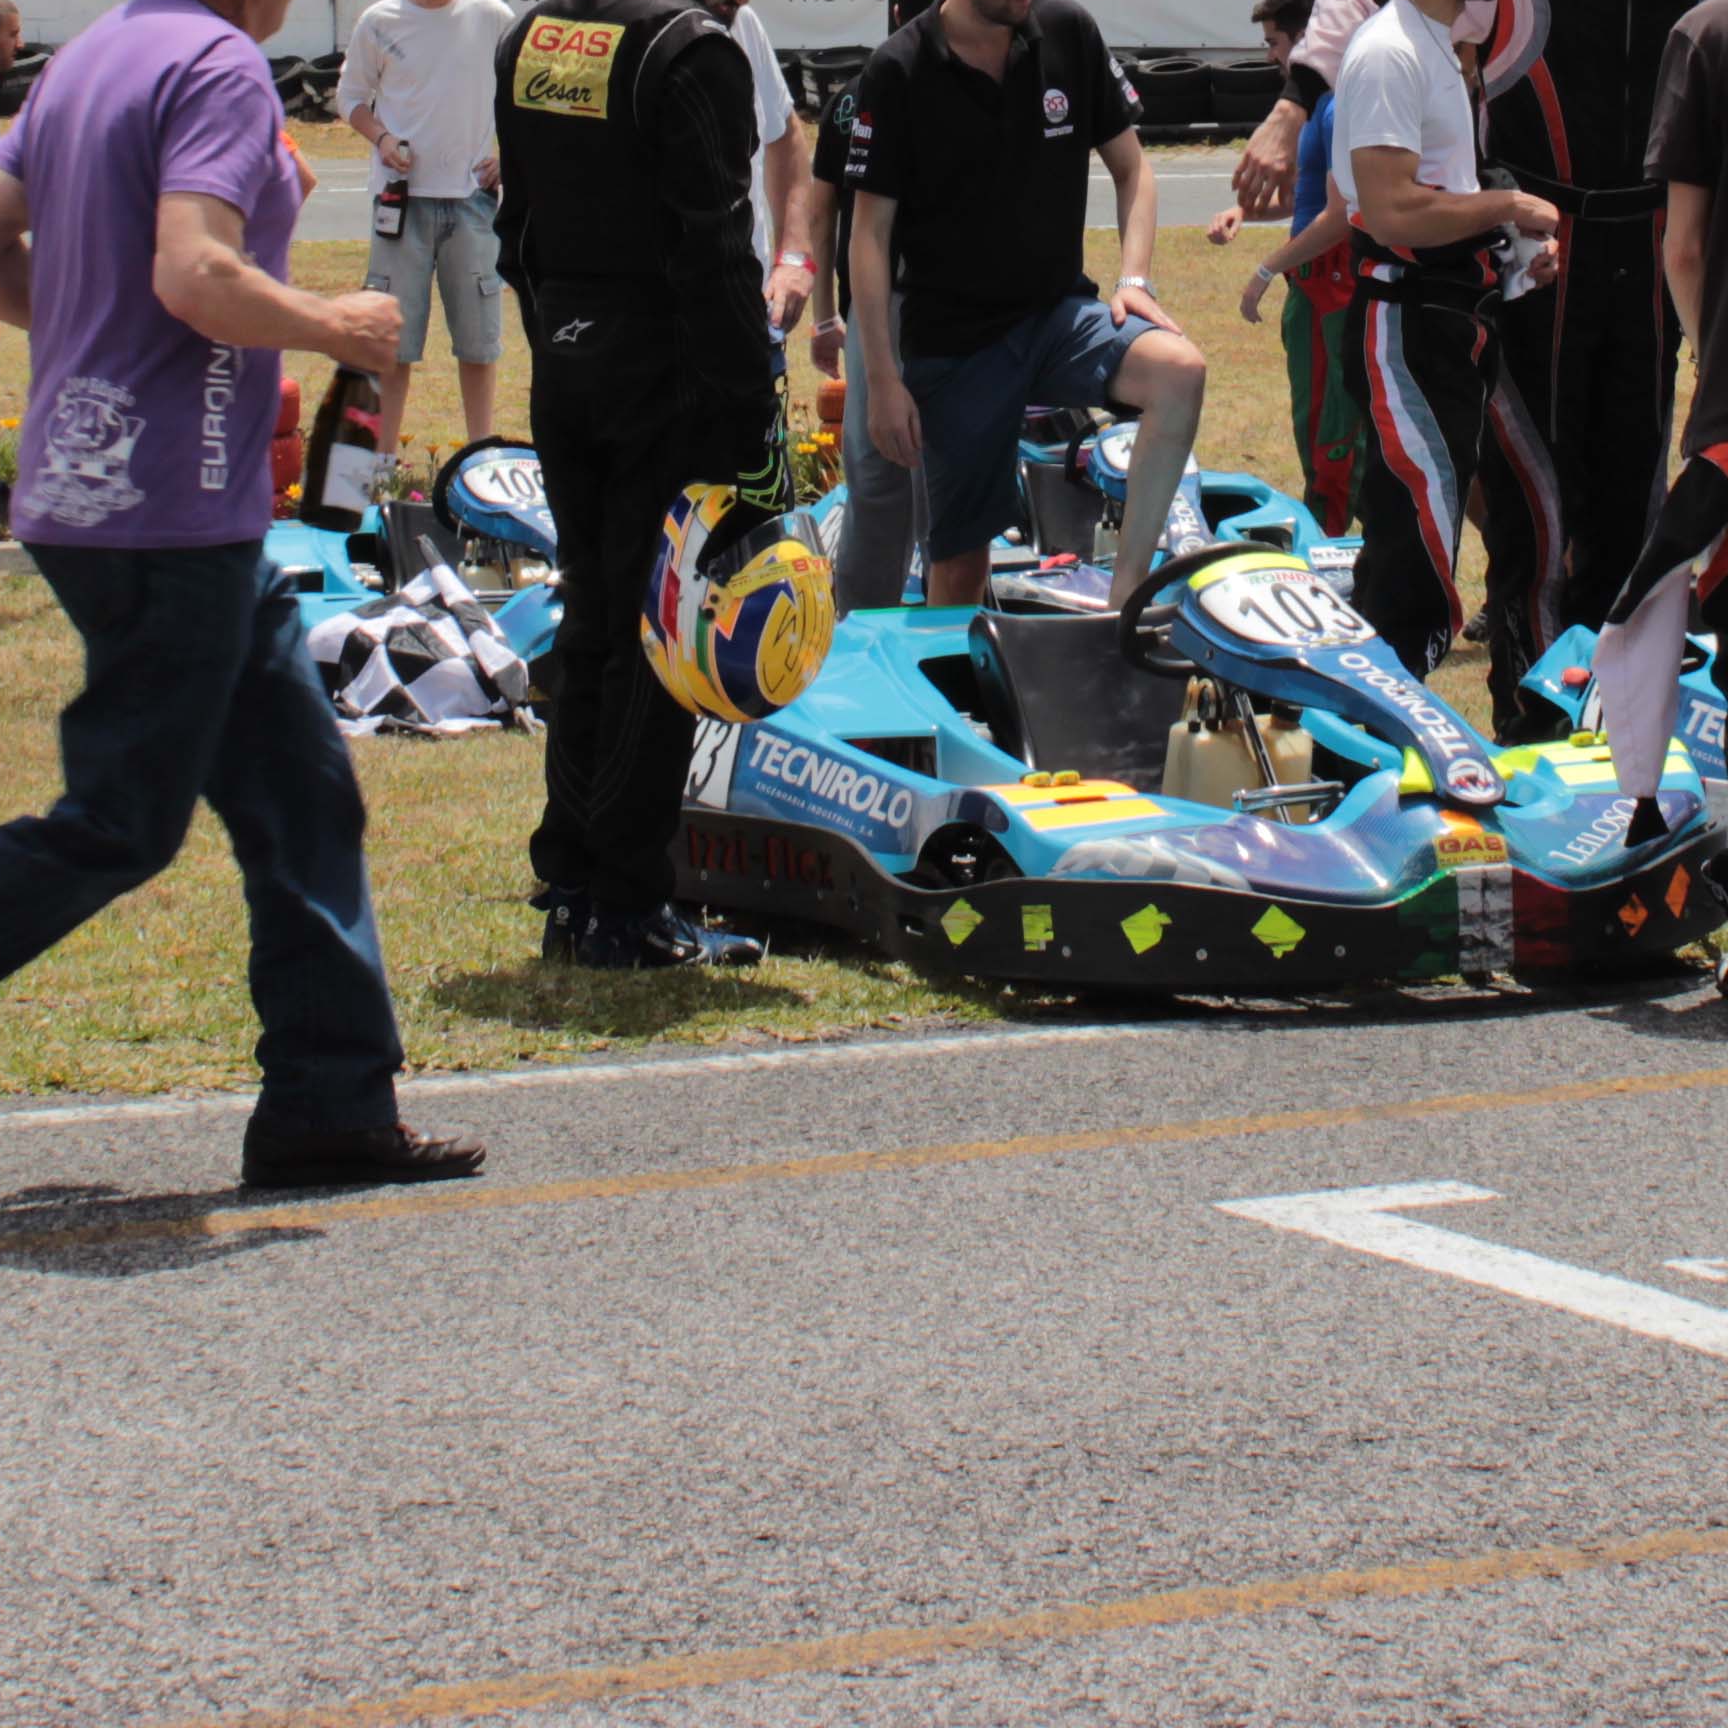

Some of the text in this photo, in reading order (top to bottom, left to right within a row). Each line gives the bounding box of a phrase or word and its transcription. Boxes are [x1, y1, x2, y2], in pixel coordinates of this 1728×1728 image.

[530, 24, 612, 58] GAS
[525, 69, 593, 101] Cesar
[200, 347, 232, 490] EUROIN
[1238, 581, 1365, 639] 103
[1339, 652, 1470, 759] TECNIROLO
[748, 730, 913, 829] TECNIROLO
[755, 781, 806, 808] ENGENHARIA
[1548, 797, 1639, 866] LEILOSO
